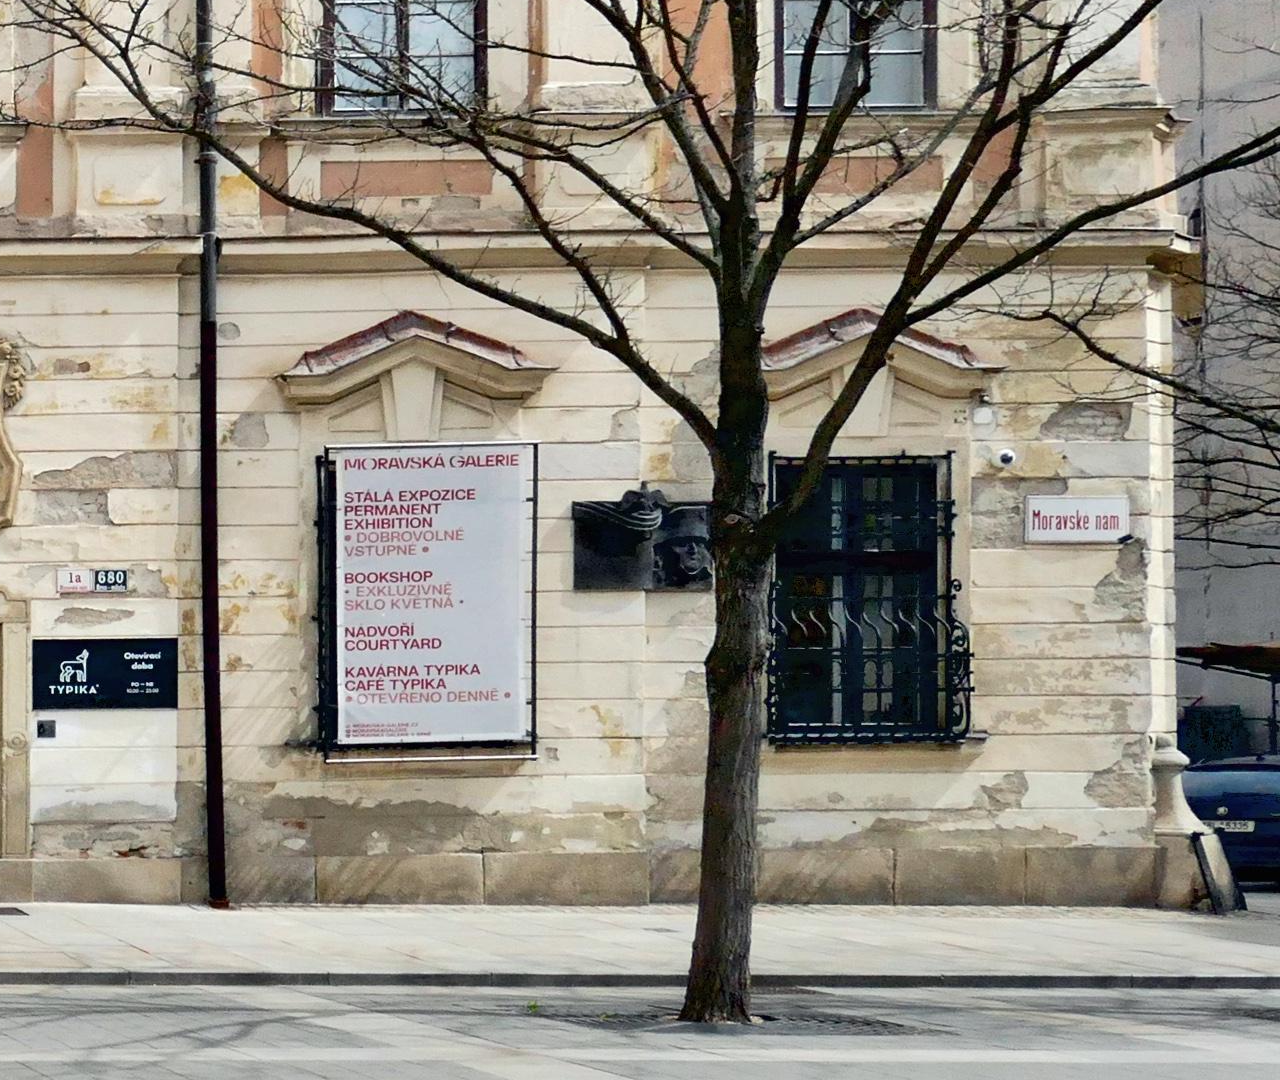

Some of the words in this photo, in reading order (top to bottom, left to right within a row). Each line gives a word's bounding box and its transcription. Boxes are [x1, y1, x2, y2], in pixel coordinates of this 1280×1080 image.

[344, 453, 445, 470] MORAVSKÁ
[450, 454, 520, 468] GALERIE
[344, 488, 393, 503] STÁLÁ
[398, 488, 476, 502] EXPOZICE
[344, 503, 442, 517] PERMANENT
[344, 517, 433, 530] EXHIBITION
[356, 527, 464, 543] DOBROVOLNÉ
[344, 543, 417, 557] VSTUPNÉ
[68, 572, 81, 584] 1a
[97, 571, 124, 584] 680
[344, 571, 433, 584] BOOKSHOP
[344, 598, 386, 611] SKLO
[344, 622, 414, 638] NÁDVOŘÍ
[344, 638, 442, 652] COURTYARD
[131, 661, 154, 670] doba
[344, 663, 419, 678] KAVÁRNA
[424, 663, 481, 676] TYPIKA
[49, 685, 97, 694] TYPIKA
[344, 677, 385, 692] CAFÉ
[390, 678, 447, 690] TYPIKA
